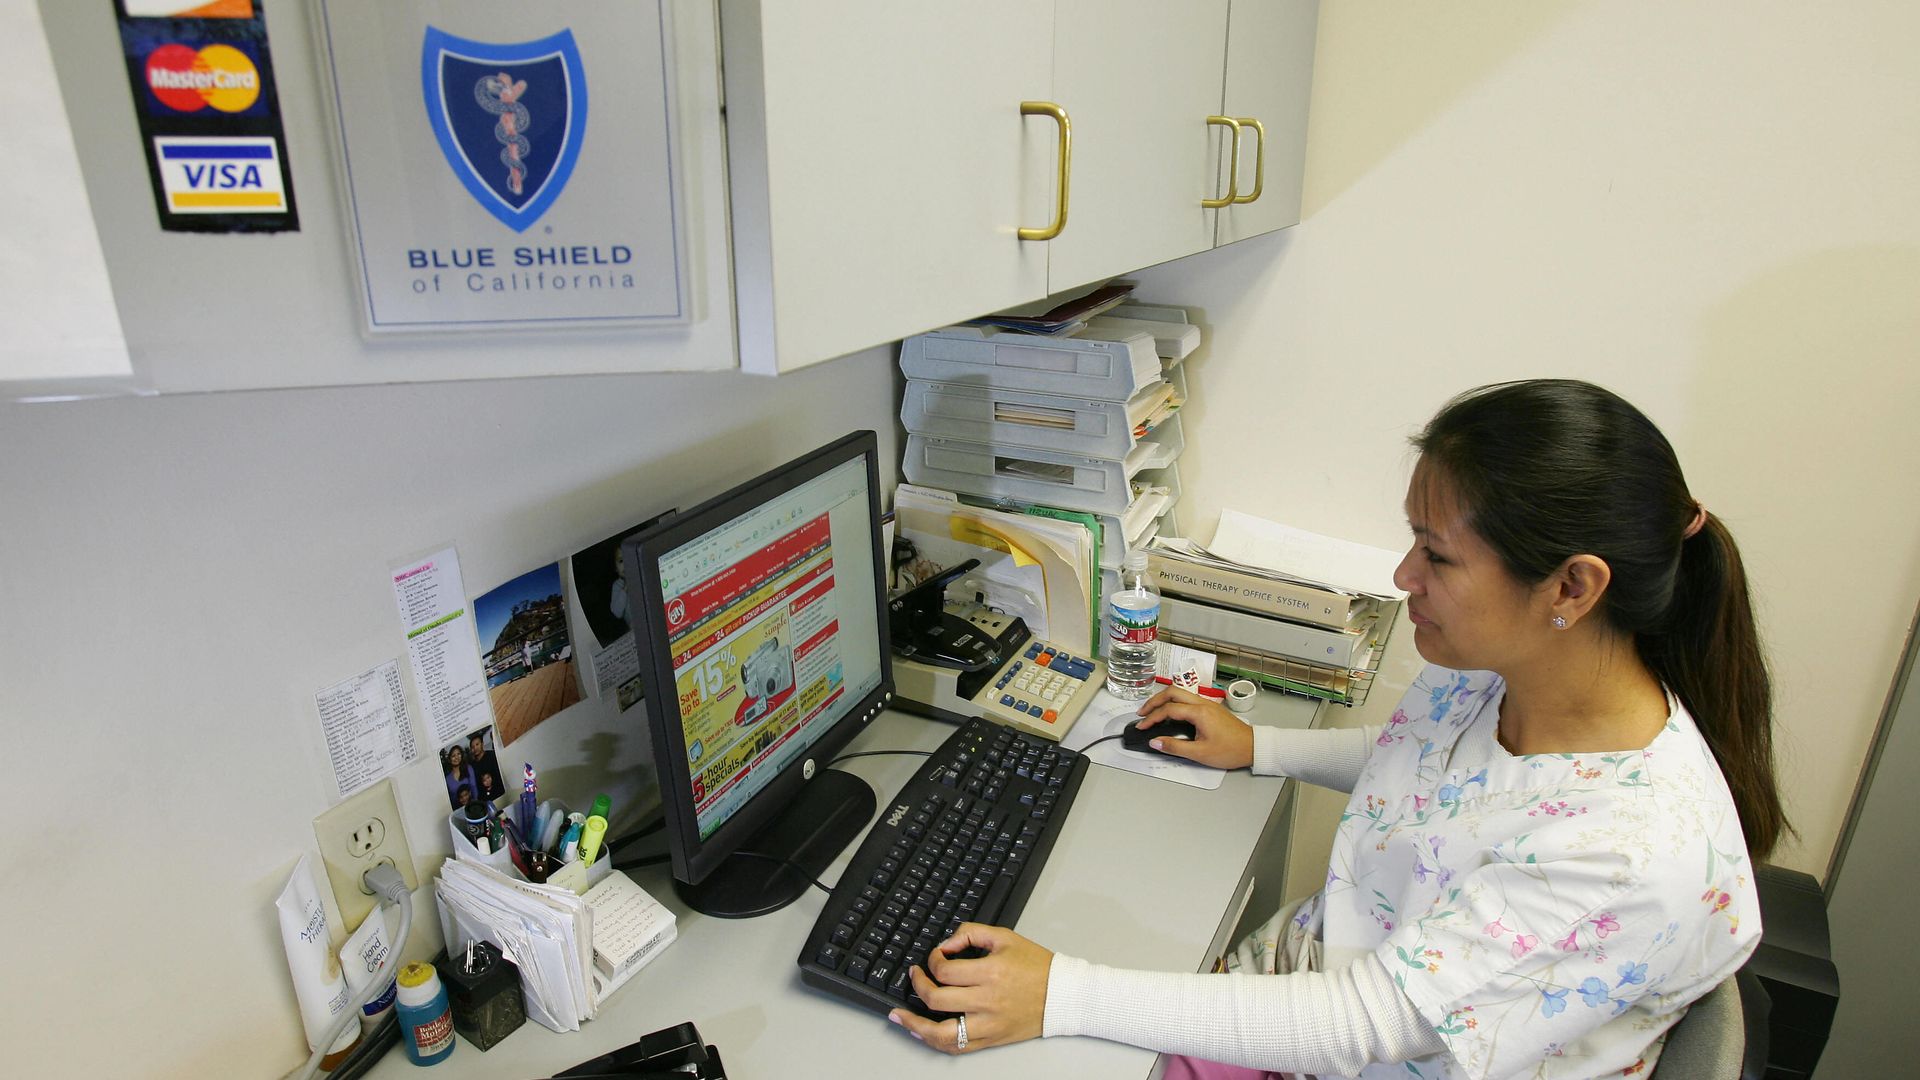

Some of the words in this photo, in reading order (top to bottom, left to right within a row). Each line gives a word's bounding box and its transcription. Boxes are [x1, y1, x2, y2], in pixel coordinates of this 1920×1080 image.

[151, 68, 256, 89] MasterCard
[183, 164, 262, 188] VISA
[408, 248, 496, 269] BLUE
[513, 246, 632, 267] SHIELD
[412, 274, 441, 293] of
[466, 270, 635, 292] California
[1159, 571, 1198, 586] PHYSICAL
[1202, 580, 1239, 595] THERAPY
[1243, 588, 1272, 602] OFFICE
[1276, 596, 1310, 610] SYSTEM
[669, 606, 685, 624] city
[764, 613, 788, 638] simple
[682, 651, 692, 662] 24
[680, 688, 698, 706] Save
[681, 702, 694, 716] up
[886, 804, 910, 827] DELL
[363, 937, 382, 963] Hand
[367, 947, 388, 973] Cream
